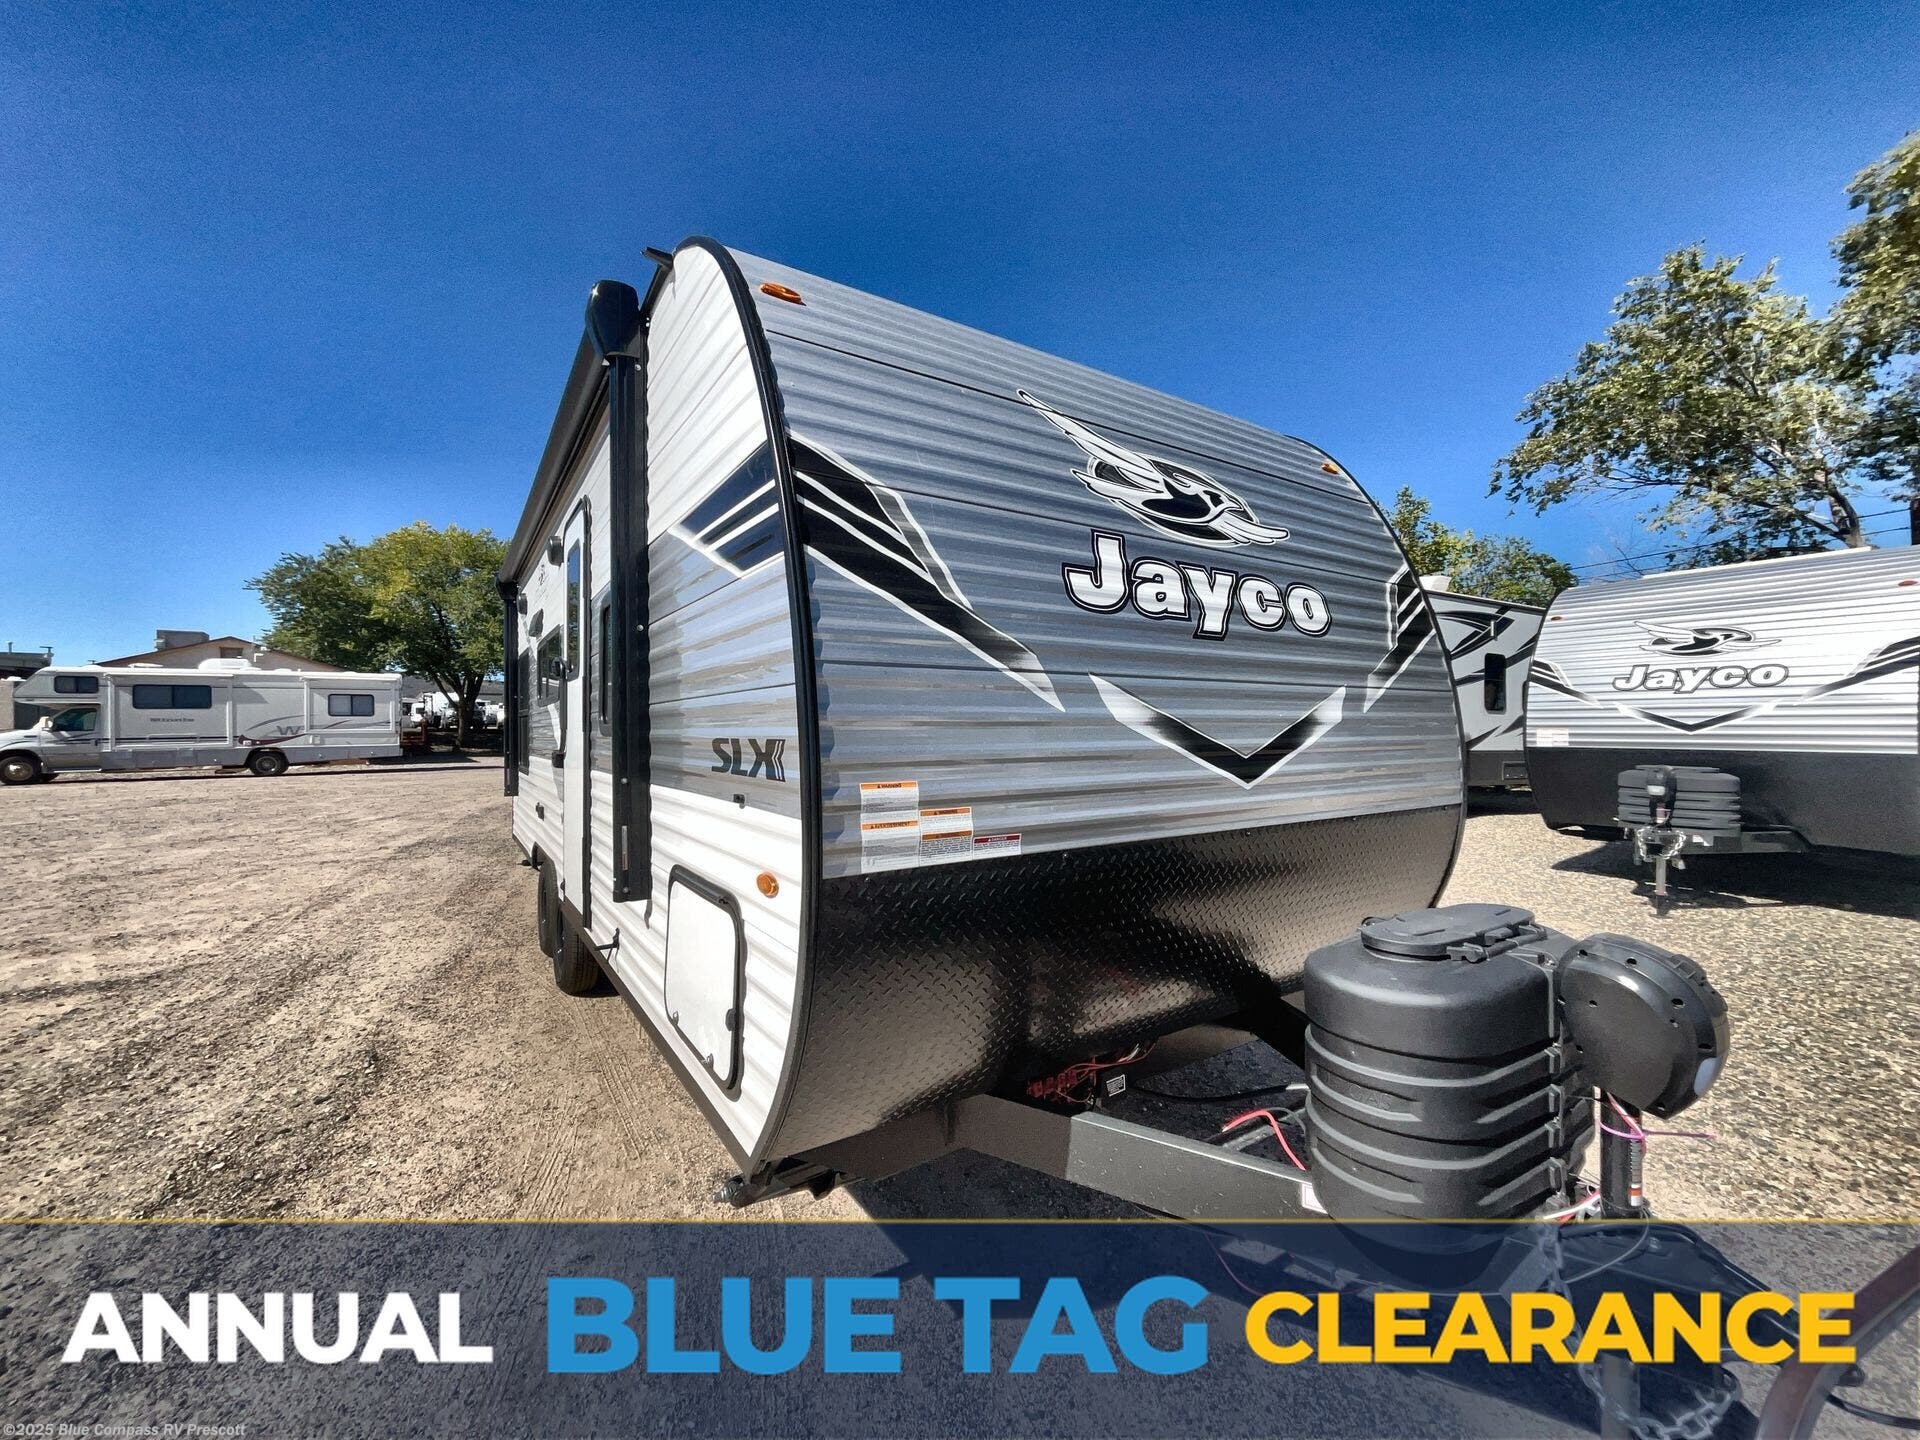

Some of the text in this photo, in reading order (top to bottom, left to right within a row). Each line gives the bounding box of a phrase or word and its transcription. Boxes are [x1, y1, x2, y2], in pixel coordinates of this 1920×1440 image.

[1061, 528, 1333, 641] Jayco
[1612, 664, 1790, 694] Jayco
[711, 737, 786, 782] SLX
